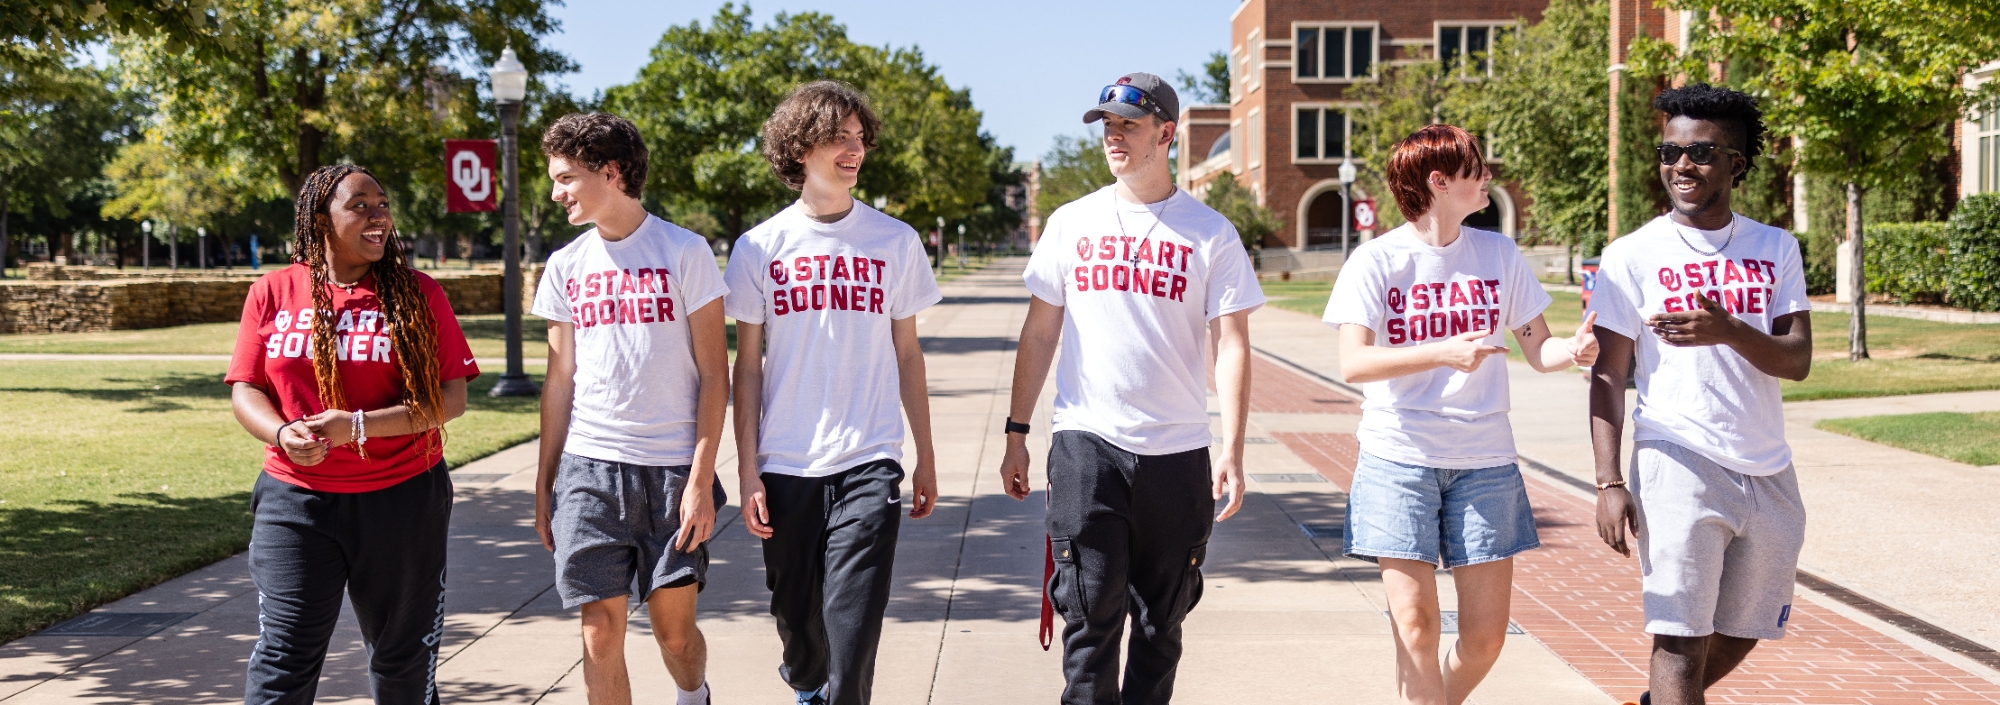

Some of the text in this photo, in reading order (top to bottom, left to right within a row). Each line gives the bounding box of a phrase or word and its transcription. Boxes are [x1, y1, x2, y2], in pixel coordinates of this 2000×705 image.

[452, 150, 491, 201] OU
[769, 255, 886, 285] OU START
[1076, 235, 1193, 273] OU START
[585, 268, 670, 298] START
[1074, 264, 1187, 303] SOONER
[1658, 258, 1776, 292] OU START
[571, 297, 675, 330] SOONER
[773, 284, 884, 316] SOONER
[1387, 279, 1500, 314] OU START
[275, 308, 391, 335] OU SART
[1387, 308, 1500, 345] SOONER
